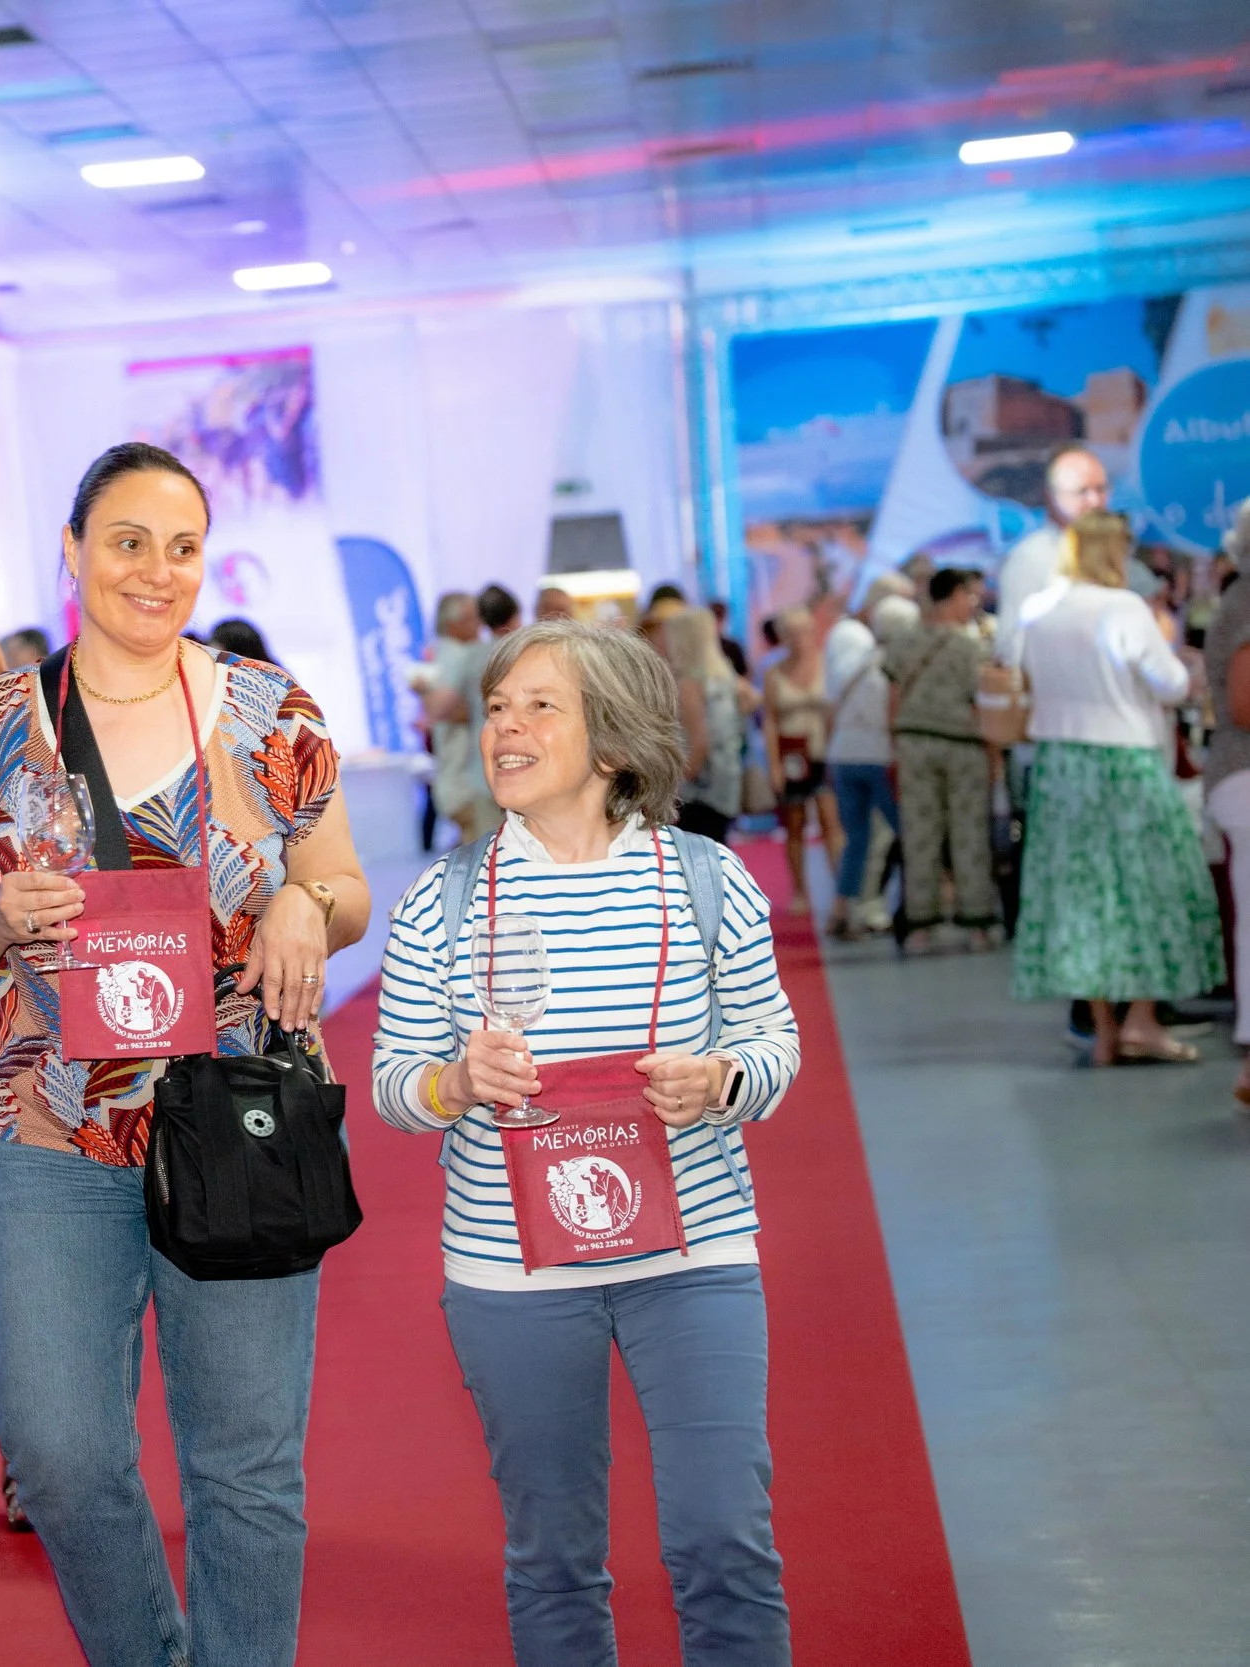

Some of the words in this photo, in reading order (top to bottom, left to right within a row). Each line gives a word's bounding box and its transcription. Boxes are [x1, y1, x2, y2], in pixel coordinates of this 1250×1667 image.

[96, 993, 117, 1031] CONFRARIA
[115, 1027, 127, 1037] DO
[169, 988, 184, 1027] ALBUFEIRA
[114, 1042, 129, 1050] Tel:
[130, 1041, 143, 1049] 962
[144, 1041, 157, 1049] 228
[533, 1124, 579, 1134] RESTAURANTE
[586, 1139, 641, 1151] MEMORIES
[548, 1193, 573, 1232] CONFRARIA
[573, 1229, 585, 1238] DO
[585, 1226, 621, 1240] BACCHUS
[620, 1221, 630, 1231] DE
[629, 1180, 642, 1223] ALBUFEIRA
[574, 1244, 589, 1252] Tel:
[590, 1242, 604, 1250] 962
[605, 1240, 618, 1248] 228
[619, 1238, 633, 1246] 930
